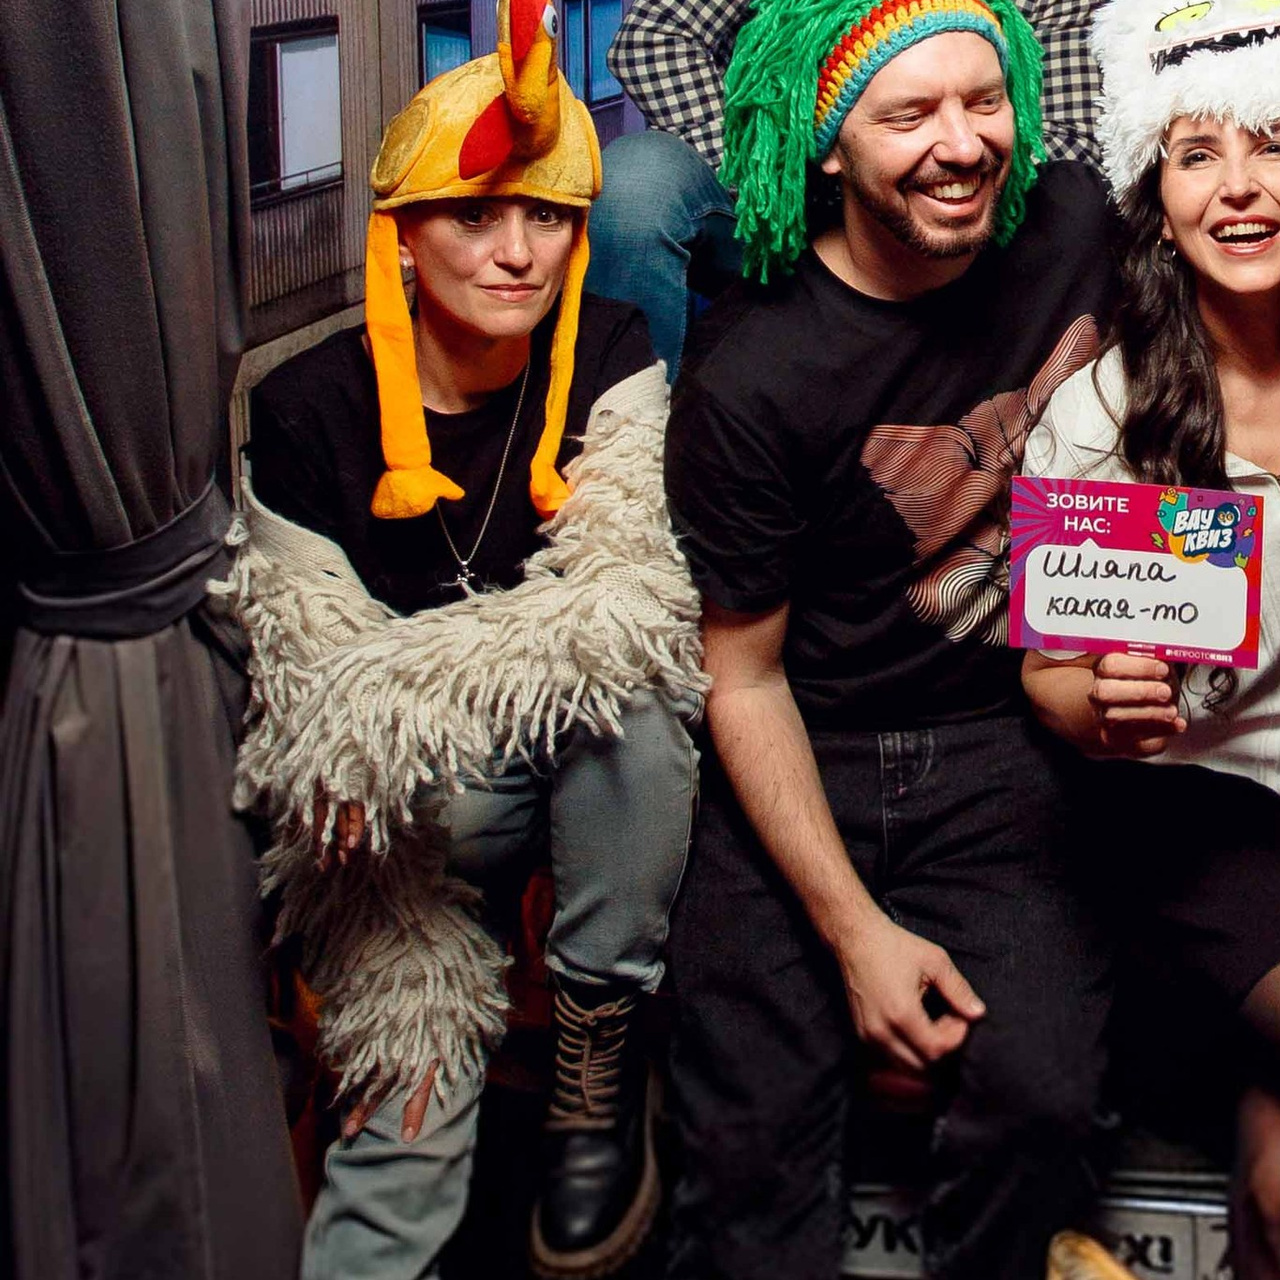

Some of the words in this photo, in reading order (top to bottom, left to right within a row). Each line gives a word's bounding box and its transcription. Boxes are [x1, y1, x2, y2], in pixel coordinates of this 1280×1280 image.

[1046, 492, 1130, 513] ЗОВИТЕ
[1063, 516, 1112, 534] НАС:
[1173, 507, 1215, 535] ВАУ
[1183, 527, 1232, 552] КВИЗ
[1042, 550, 1177, 583] Шляпа
